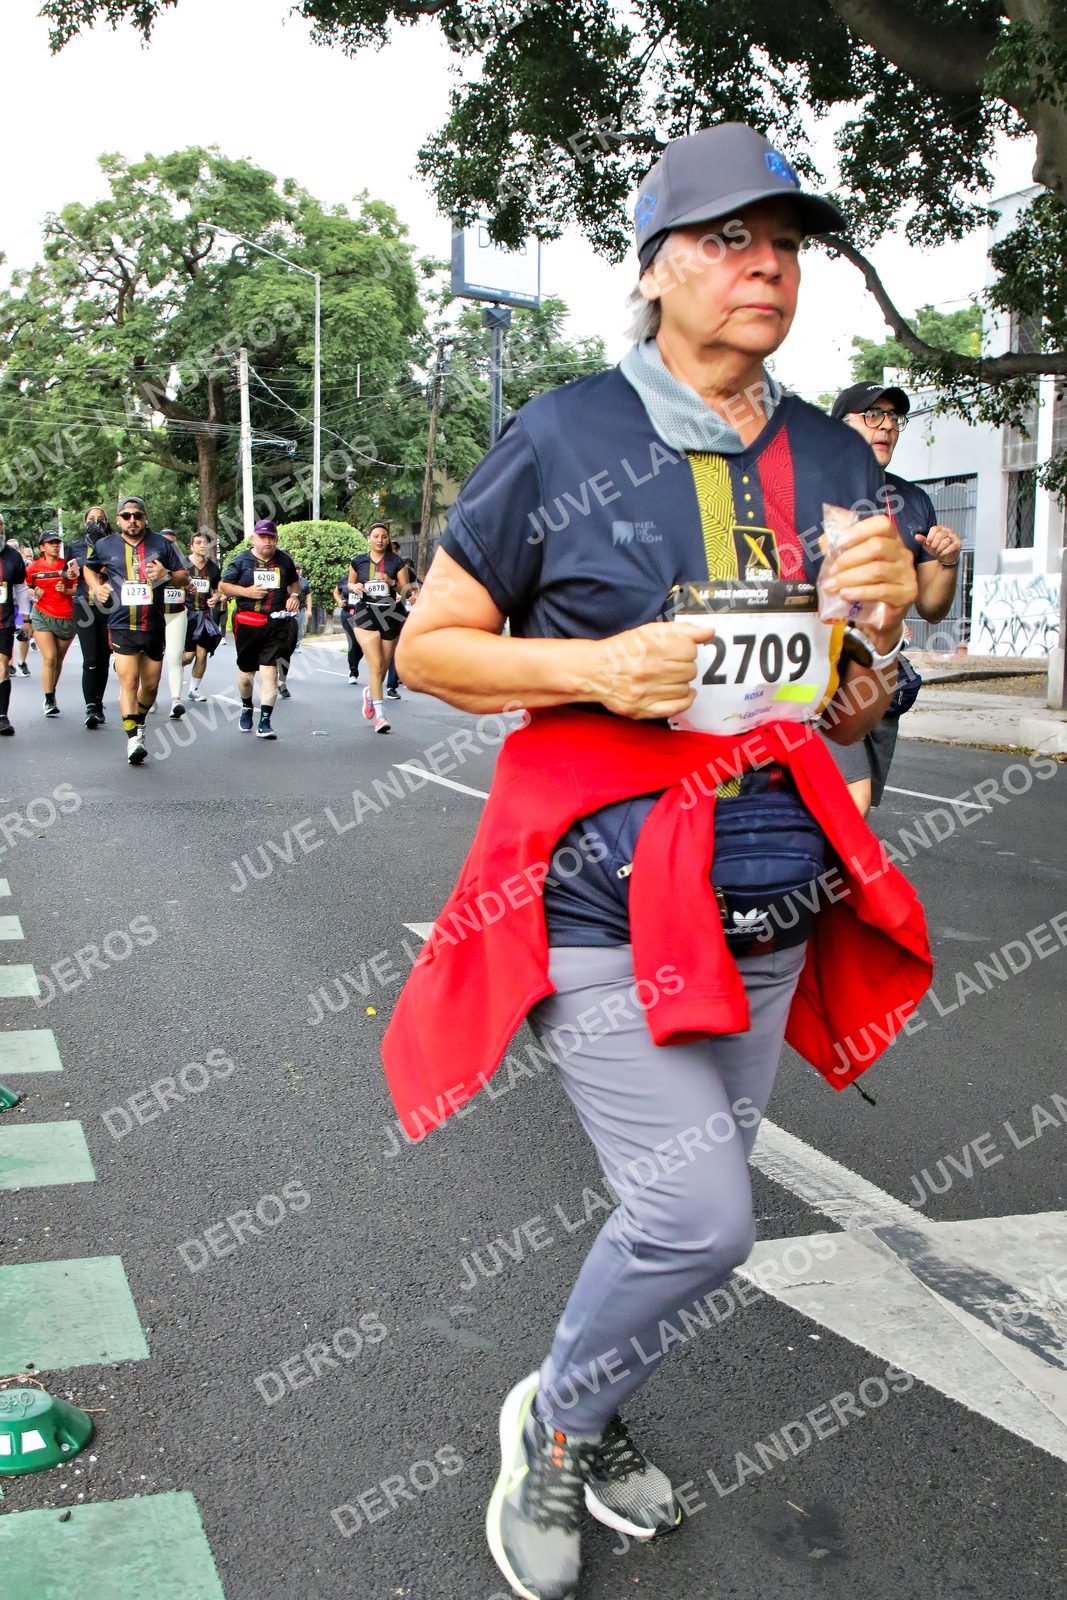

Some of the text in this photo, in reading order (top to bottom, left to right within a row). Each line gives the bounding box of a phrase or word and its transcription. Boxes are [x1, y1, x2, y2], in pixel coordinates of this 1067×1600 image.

[257, 573, 275, 581] 6208
[368, 584, 385, 593] 6878
[702, 632, 811, 686] 2709
[744, 690, 764, 701] ROSA
